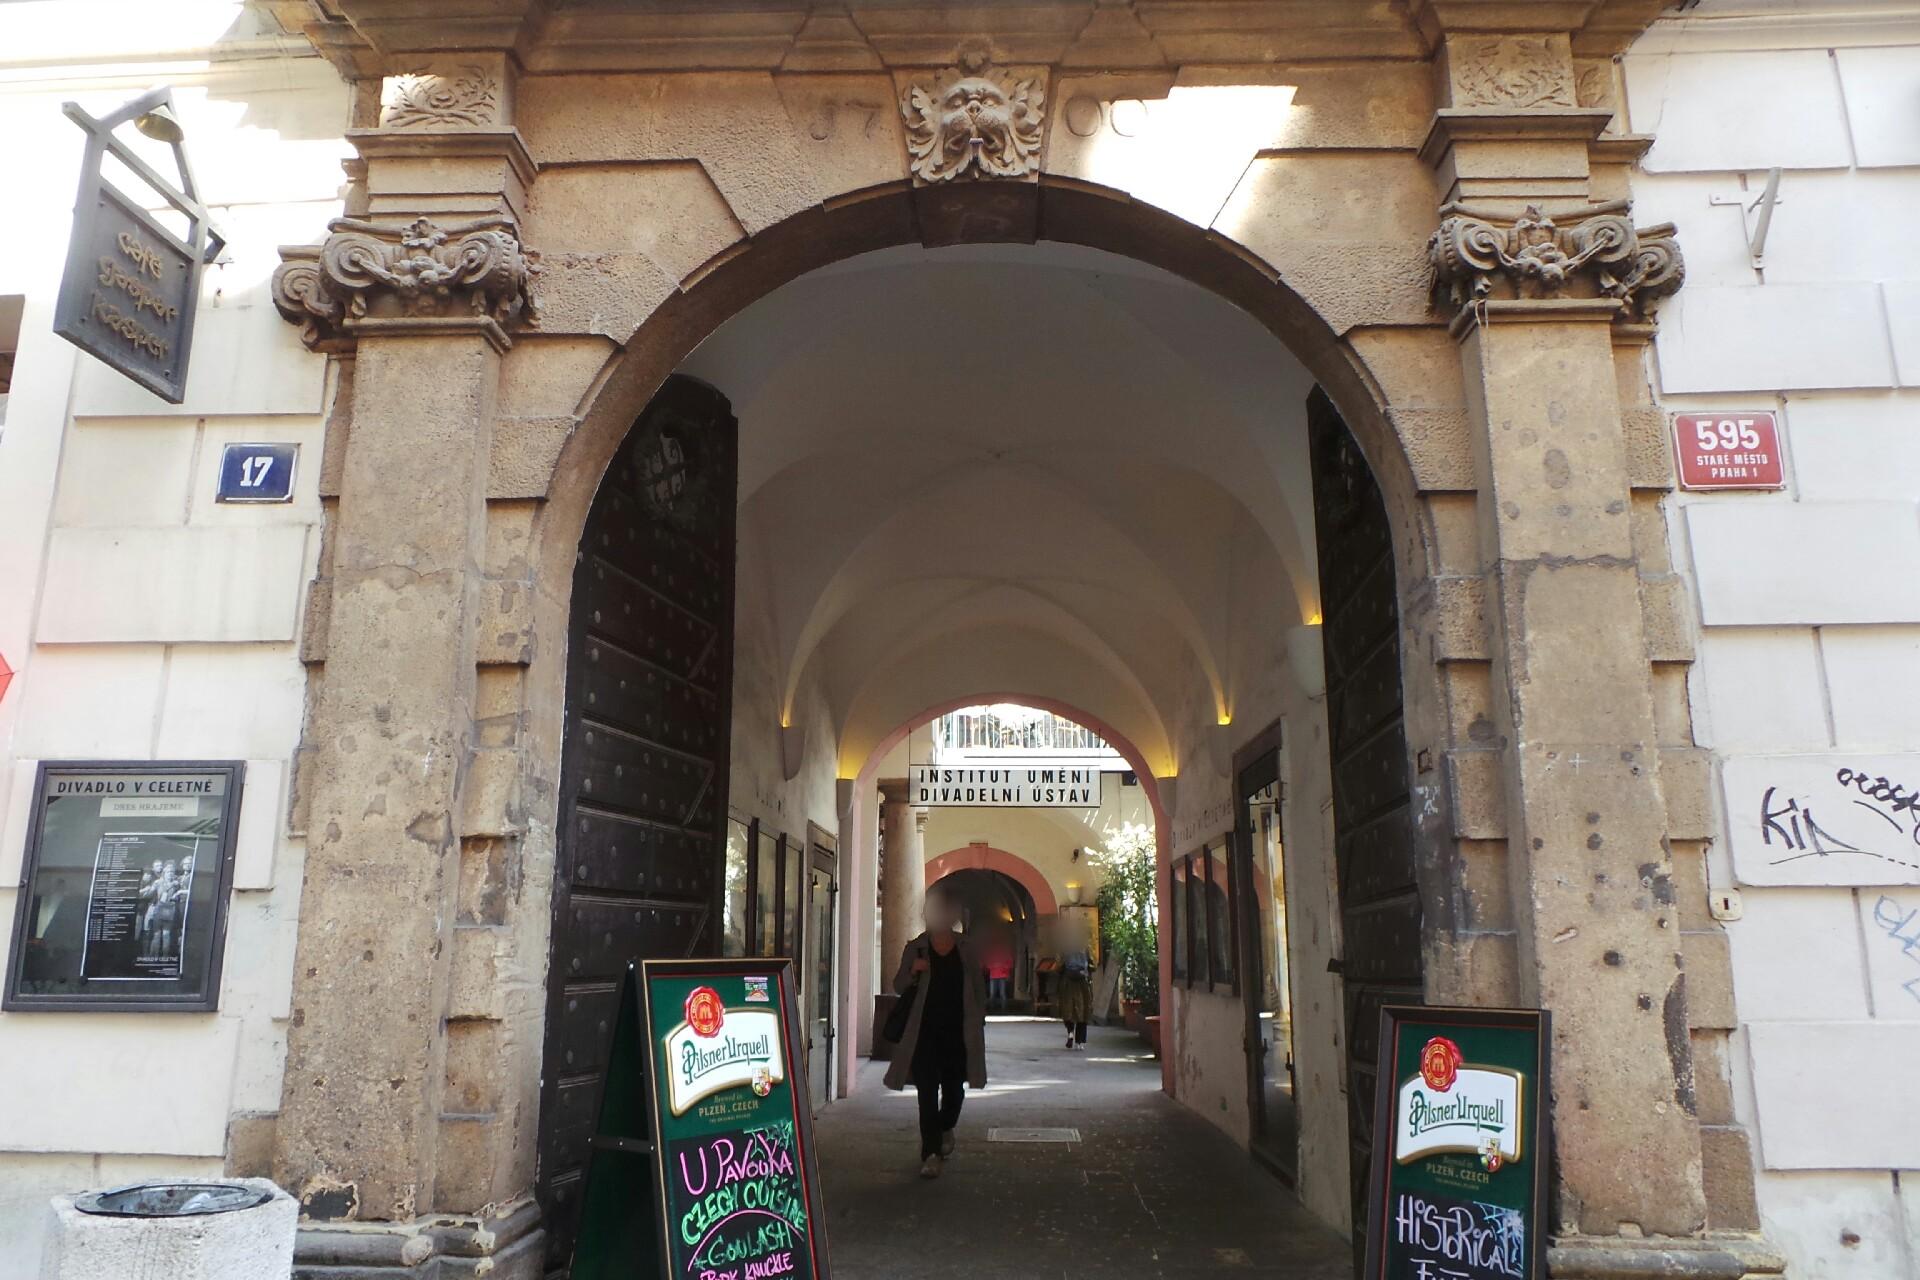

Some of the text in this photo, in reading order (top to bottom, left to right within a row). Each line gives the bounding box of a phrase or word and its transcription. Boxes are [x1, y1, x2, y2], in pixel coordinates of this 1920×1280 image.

[1695, 419, 1760, 451] 595
[1696, 451, 1769, 466] STARÉ MĚSTO
[240, 456, 274, 487] 17
[1711, 466, 1758, 479] PRAHA 1
[57, 779, 213, 793] DIVADLO V CELETNÉ
[920, 767, 1091, 783] INSTITUT UMĚNÍ
[920, 785, 1091, 803] DIVADELNÍ ÚSTAV
[682, 1034, 769, 1086] Pilsner Urquell
[1409, 1089, 1504, 1138] Pilsner Urquell
[679, 1147, 708, 1195] U
